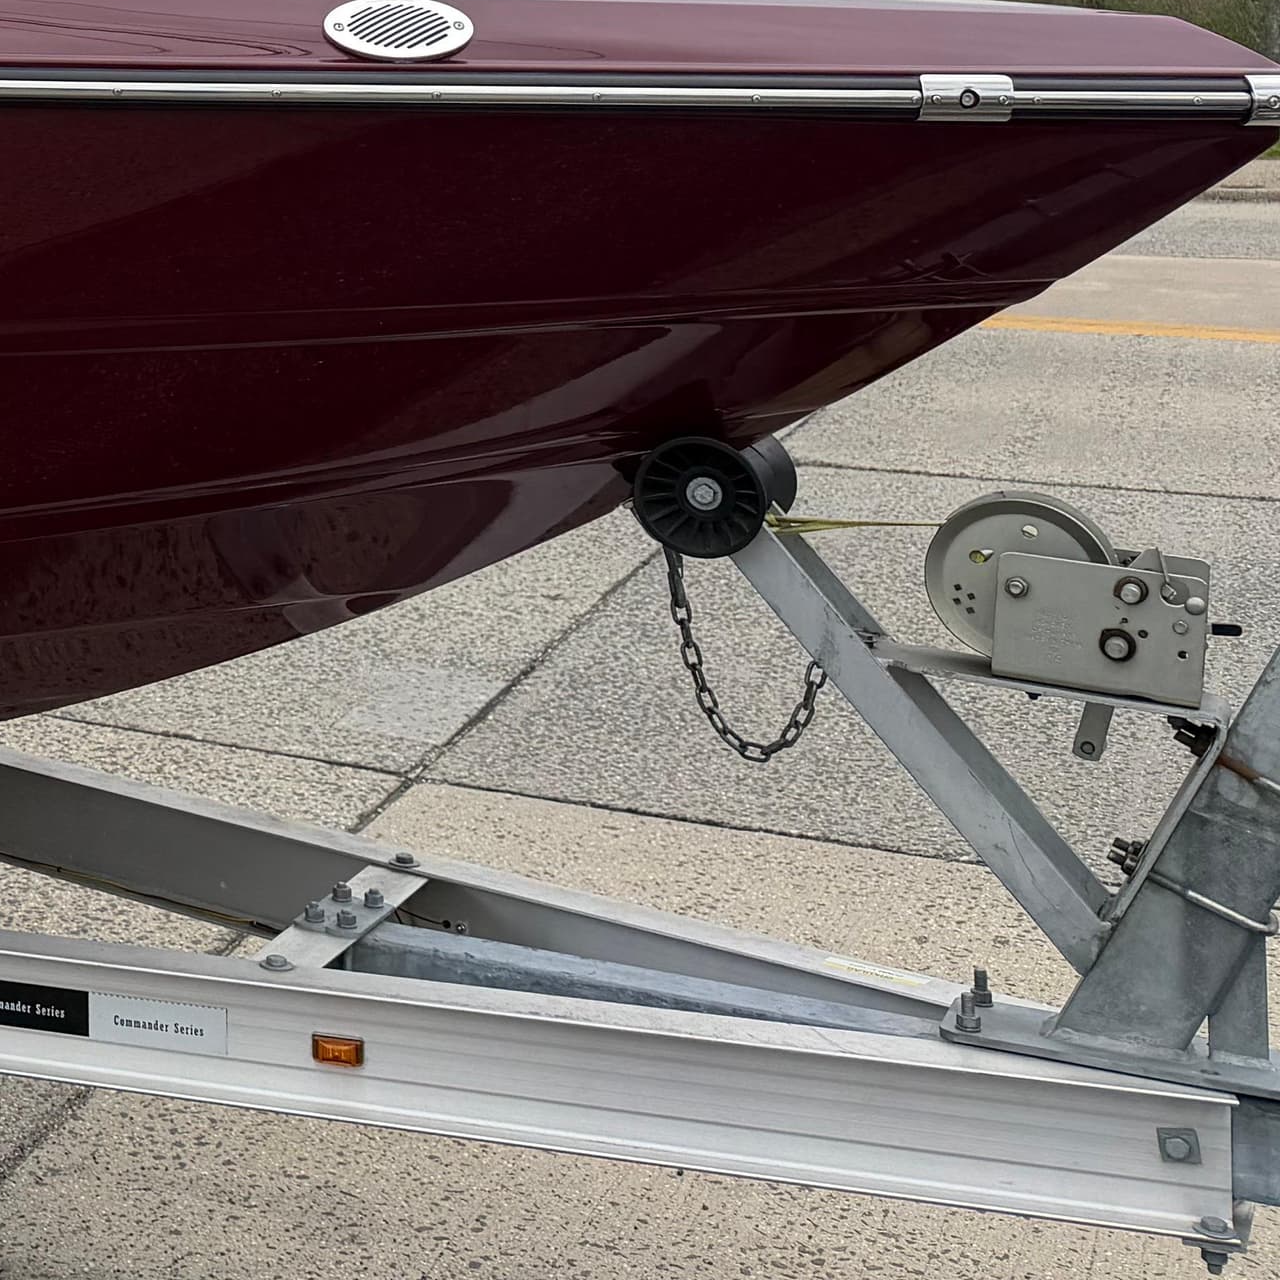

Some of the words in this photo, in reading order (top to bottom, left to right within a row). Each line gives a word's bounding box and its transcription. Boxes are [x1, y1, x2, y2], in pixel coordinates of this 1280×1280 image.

[35, 1003, 65, 1019] Series
[113, 1014, 169, 1033] Commander
[173, 1022, 204, 1037] Series
